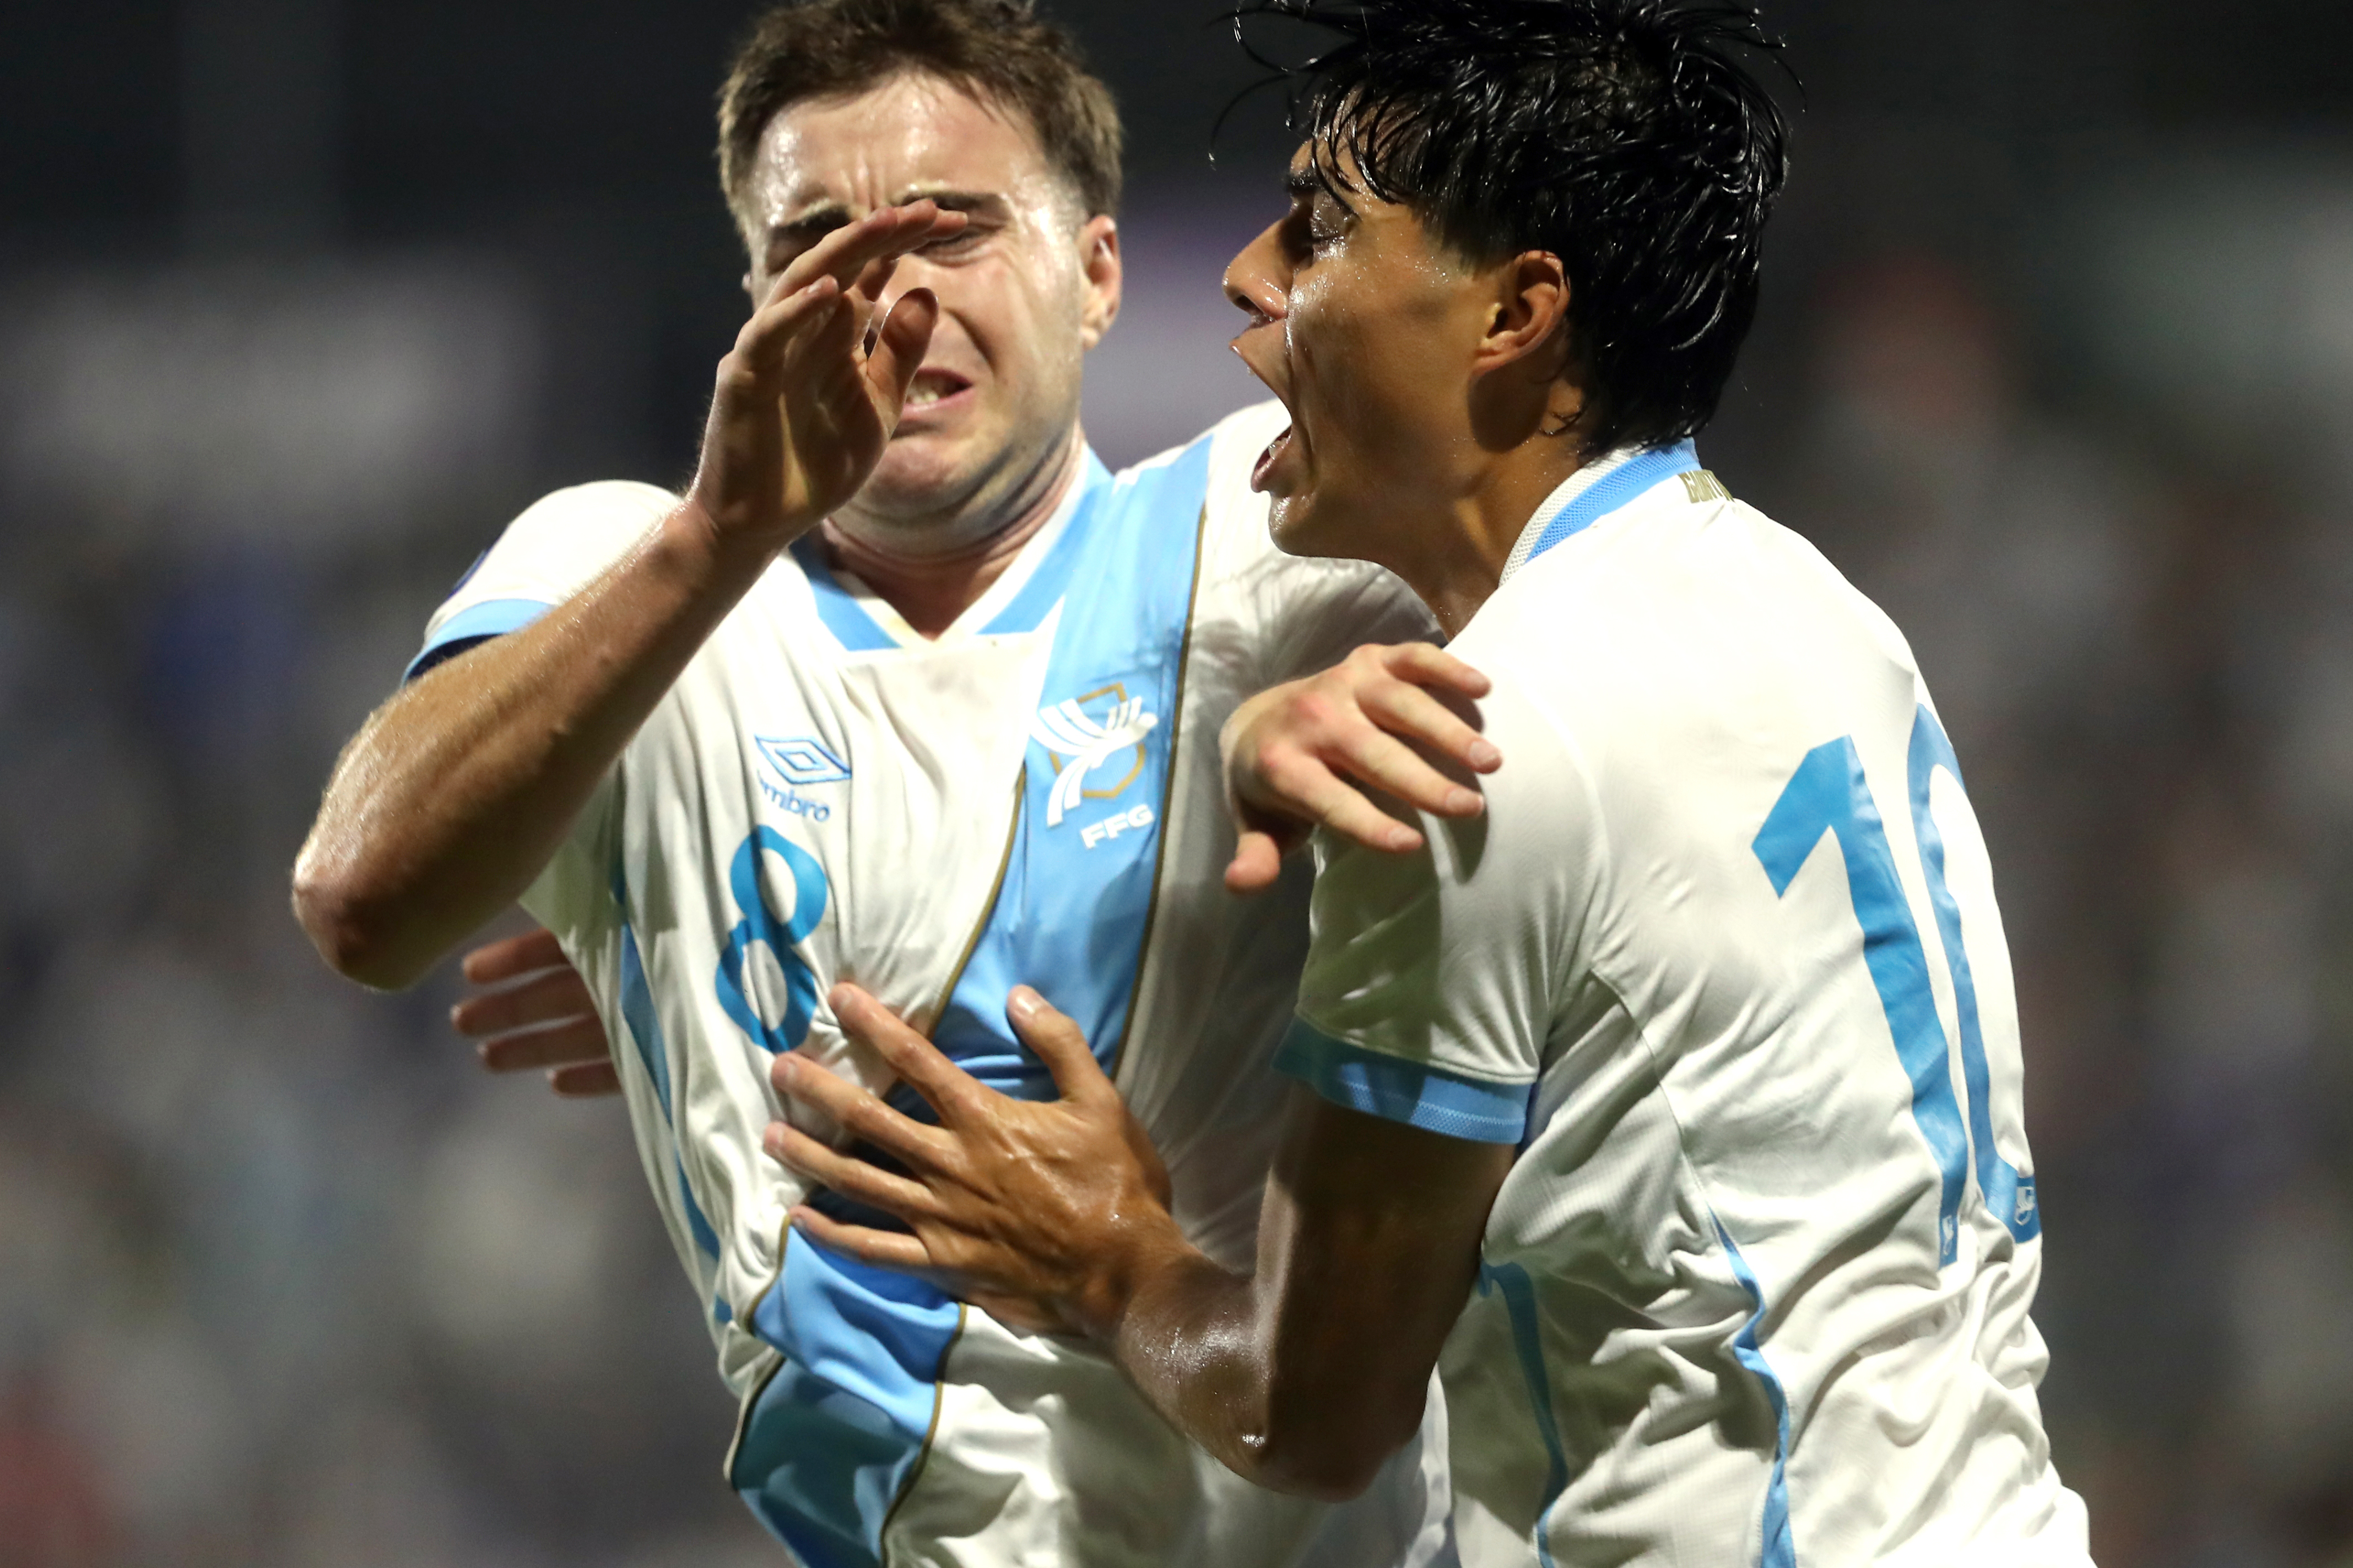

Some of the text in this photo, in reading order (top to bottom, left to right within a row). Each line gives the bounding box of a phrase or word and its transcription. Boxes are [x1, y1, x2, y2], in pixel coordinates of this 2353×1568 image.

[715, 824, 827, 1052] 8
[1081, 804, 1155, 849] FFG
[1751, 702, 2041, 1269] 10
